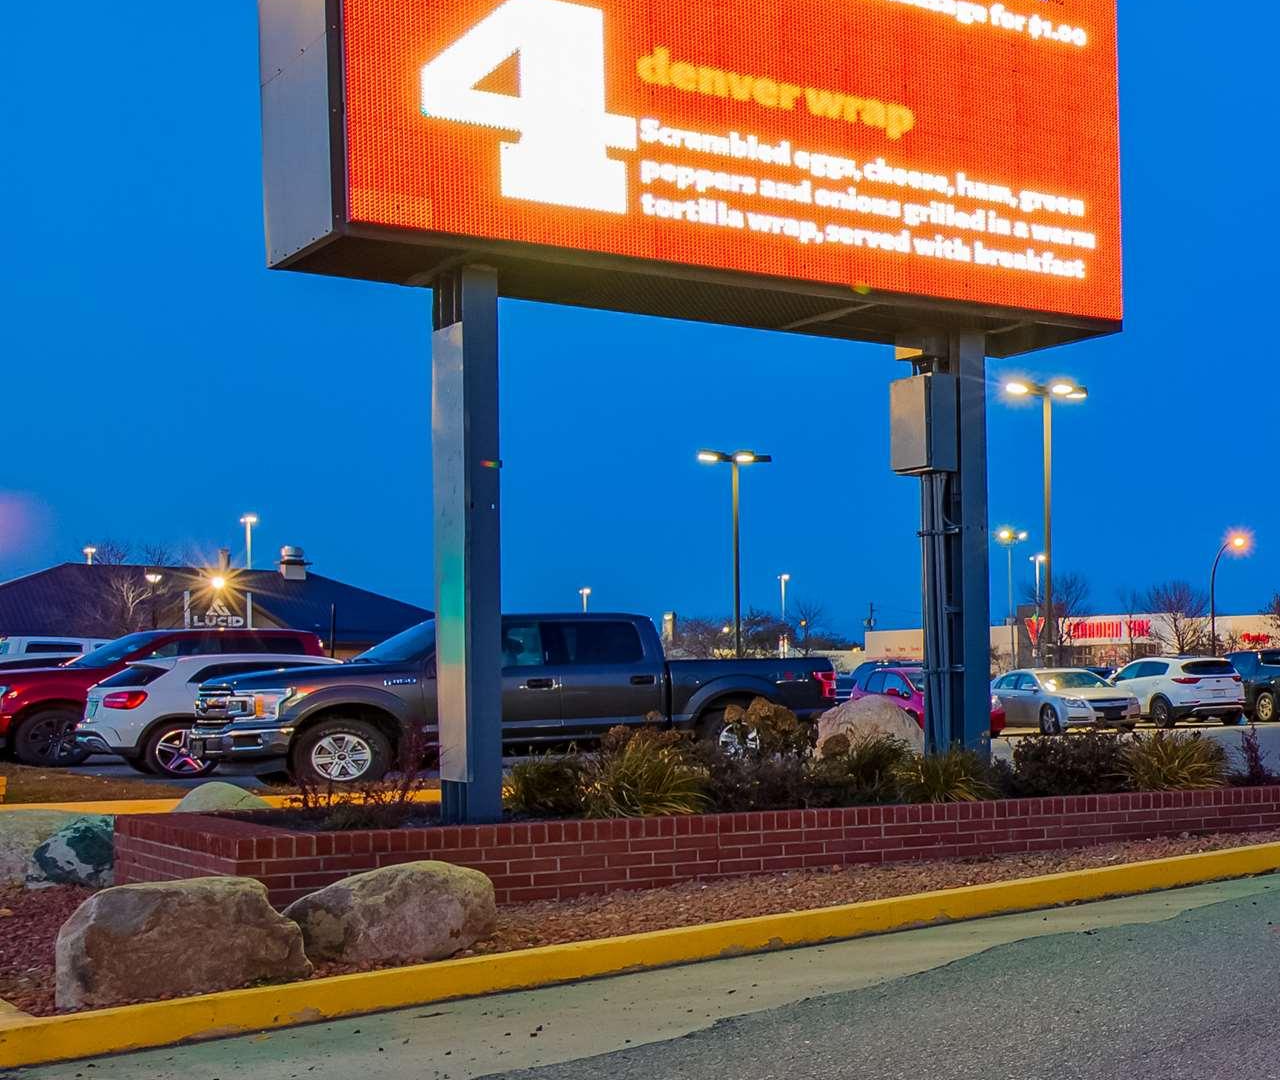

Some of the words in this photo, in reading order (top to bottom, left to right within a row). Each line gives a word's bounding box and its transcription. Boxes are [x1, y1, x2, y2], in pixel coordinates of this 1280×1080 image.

[989, 2, 1026, 32] for
[636, 45, 801, 111] denver
[804, 86, 916, 141] wrap
[640, 116, 791, 167] Scrambled
[794, 149, 862, 183] eggs,
[863, 156, 955, 197] cheese,
[956, 171, 1018, 208] ham,
[1019, 189, 1085, 217] green
[640, 159, 757, 193] peppers
[759, 178, 812, 204] and
[814, 185, 901, 218] onions
[903, 200, 986, 232] grilled
[987, 210, 1011, 235] in
[1012, 220, 1030, 239] a
[1030, 223, 1096, 249] warm
[640, 192, 745, 229] tortilla
[746, 211, 825, 244] wrap,
[825, 223, 911, 253] served
[912, 233, 971, 262] with
[973, 240, 1086, 279] breakfast
[192, 614, 245, 627] LUCID
